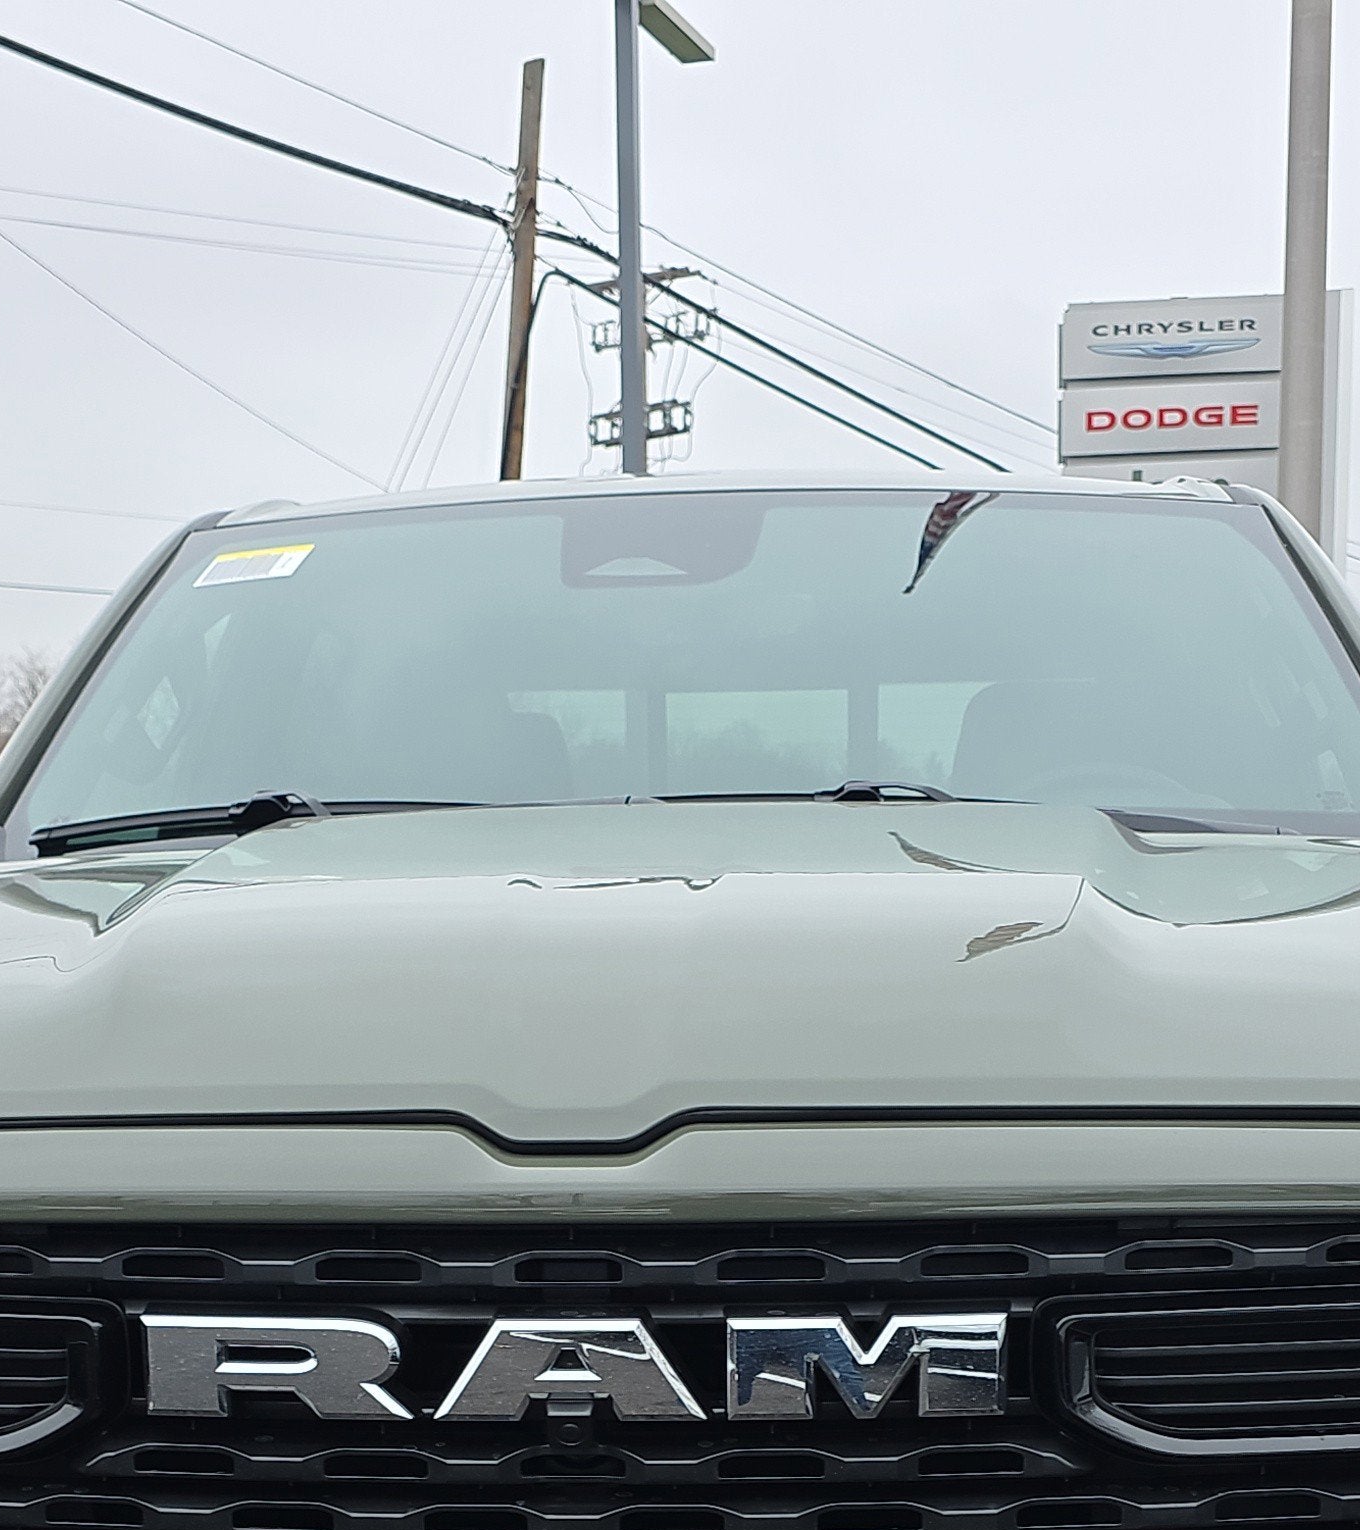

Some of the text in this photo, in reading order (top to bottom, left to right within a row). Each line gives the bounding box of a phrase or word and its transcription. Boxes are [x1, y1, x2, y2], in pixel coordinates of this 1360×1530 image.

[1091, 319, 1257, 337] CHRYSLER
[1085, 404, 1260, 433] DODGE
[139, 1312, 1009, 1422] RAM
